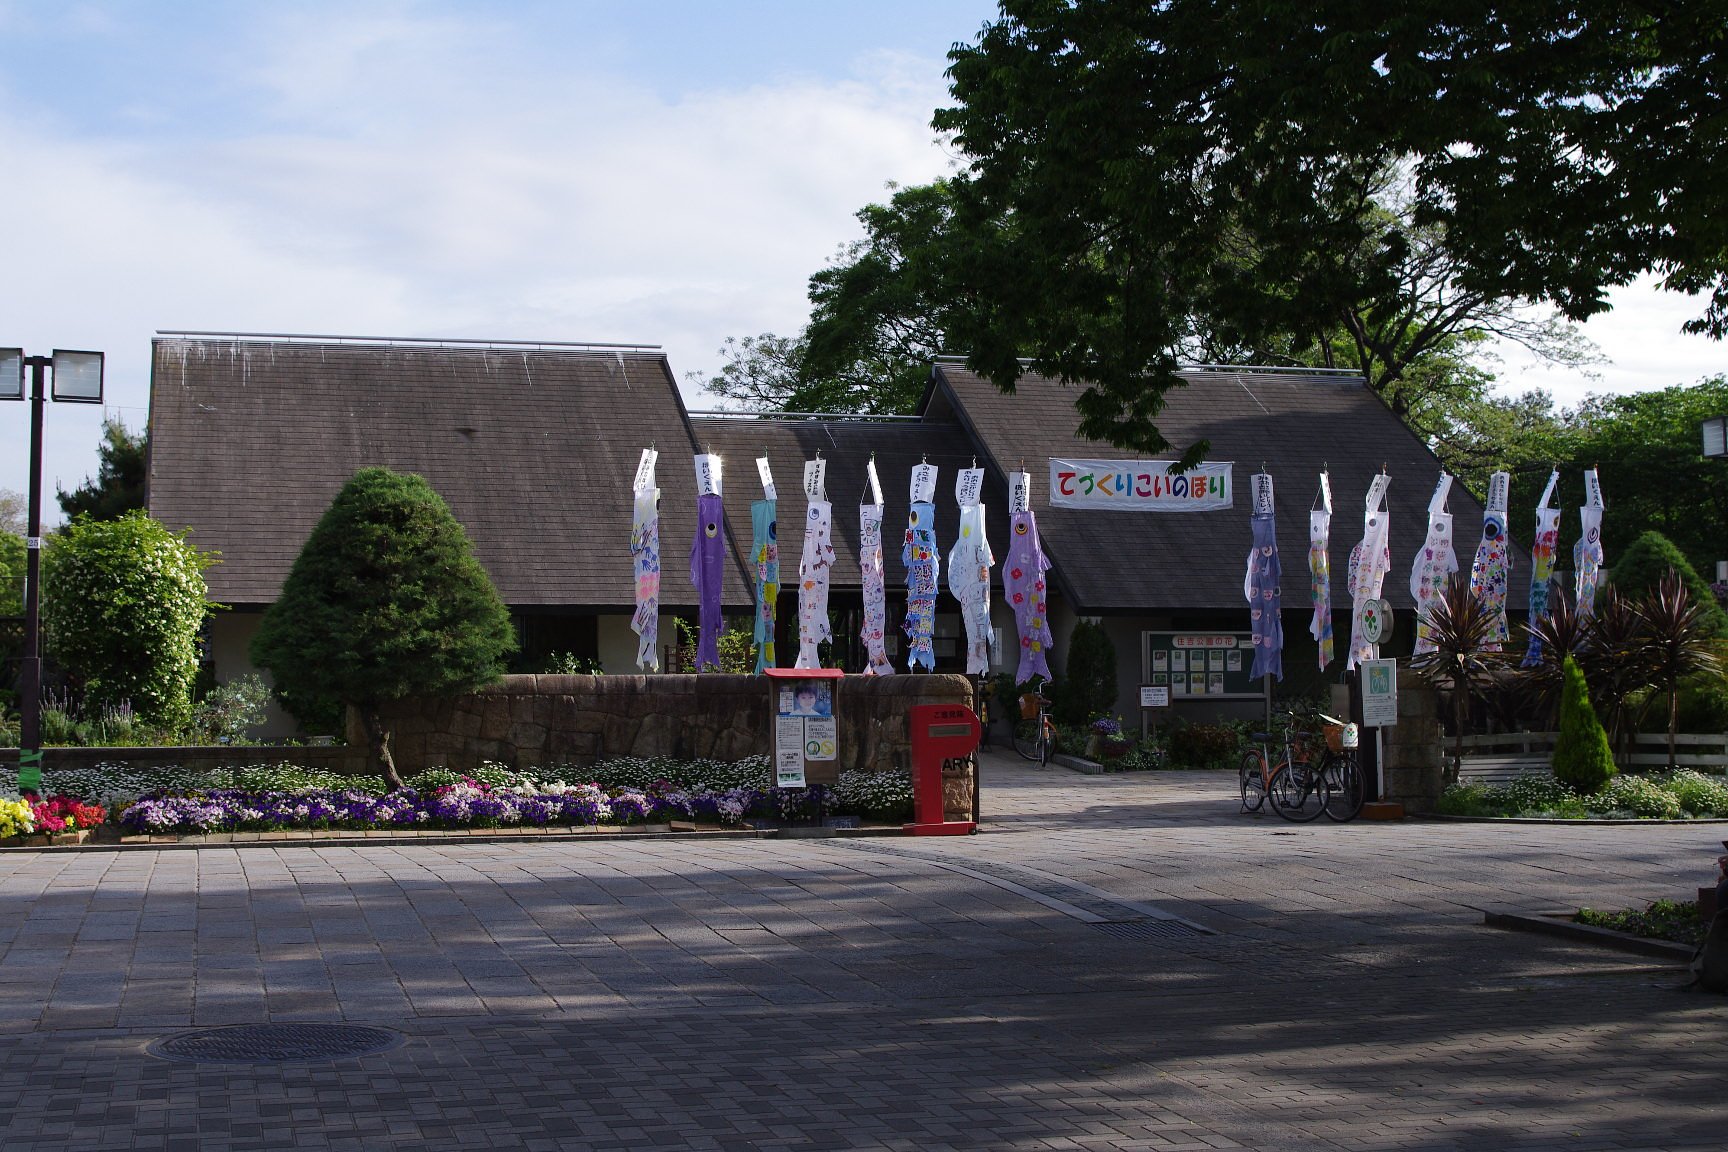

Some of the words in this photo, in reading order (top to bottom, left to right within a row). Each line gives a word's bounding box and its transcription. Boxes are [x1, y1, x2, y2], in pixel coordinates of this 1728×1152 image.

[1058, 472, 1225, 498] てづくりこいのぼり
